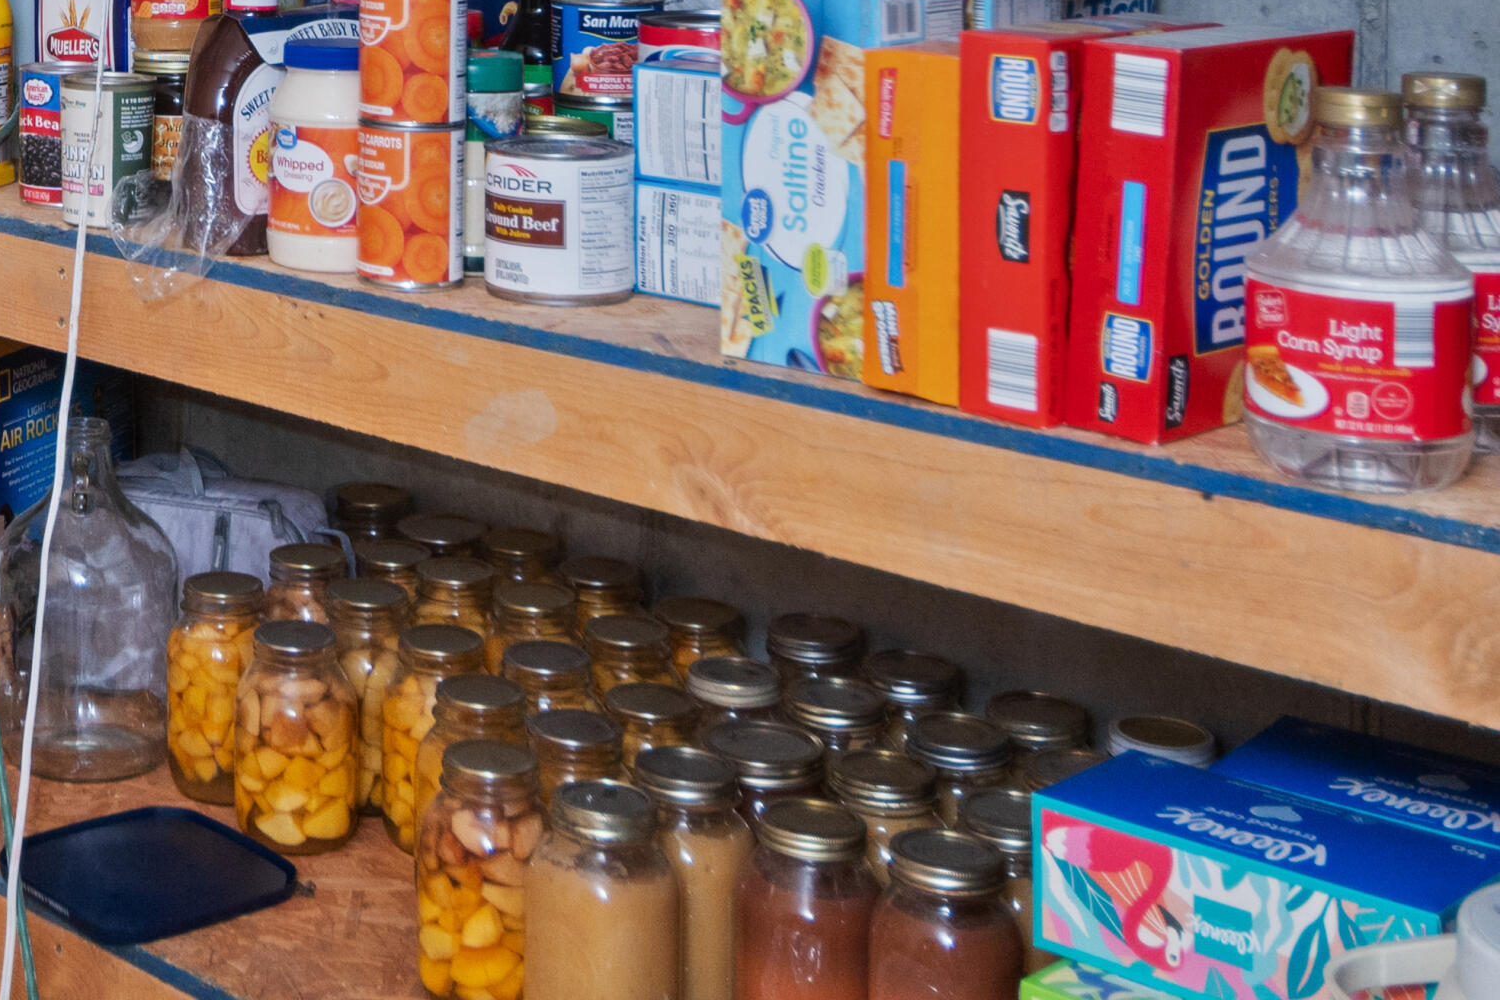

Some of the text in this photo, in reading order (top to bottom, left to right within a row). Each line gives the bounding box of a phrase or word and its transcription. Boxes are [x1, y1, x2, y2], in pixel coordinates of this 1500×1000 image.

[318, 21, 348, 38] BABY
[582, 14, 607, 29] San
[50, 37, 99, 59] MUELLER'S
[240, 87, 270, 122] SWEET
[1000, 57, 1030, 121] ROUND
[365, 133, 403, 150] CARROTS
[276, 154, 325, 172] Whipped
[781, 116, 809, 234] Saltine
[811, 143, 827, 208] Crackers
[486, 173, 553, 194] CRIDER
[668, 193, 678, 217] 360
[747, 196, 761, 239] Great
[521, 213, 560, 233] Beef
[1210, 133, 1268, 346] ROUND
[639, 215, 647, 289] Nutrition Facts
[1197, 188, 1216, 302] GOLDEN
[739, 258, 761, 316] PACKS
[1110, 316, 1141, 379] ROUND
[1276, 329, 1384, 364] Corn Syrup
[1328, 318, 1384, 343] Light
[11, 358, 48, 382] NATIONAL
[12, 367, 58, 394] GEOGRAPHIC
[0, 428, 24, 453] AIR
[1328, 775, 1500, 836] Kleenex
[1155, 805, 1328, 867] Kleenex
[1185, 912, 1267, 956] Kleenex
